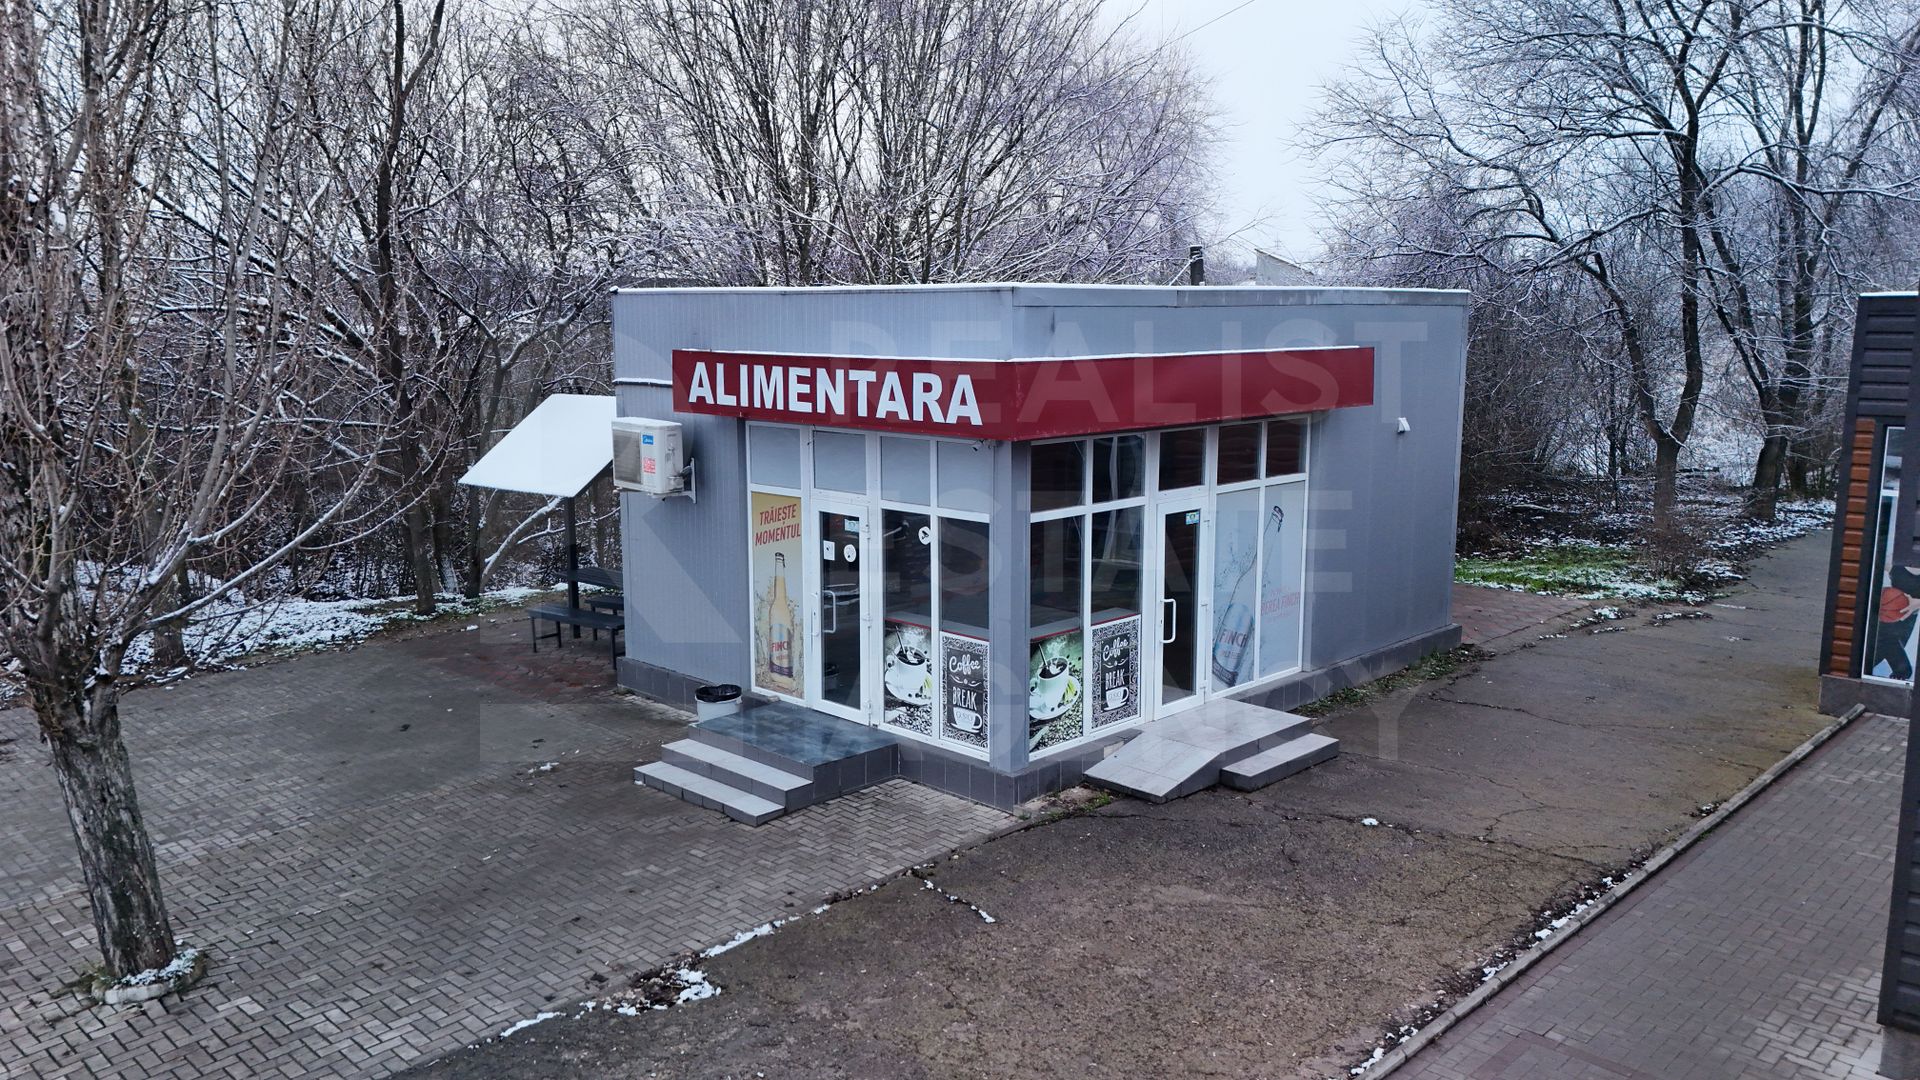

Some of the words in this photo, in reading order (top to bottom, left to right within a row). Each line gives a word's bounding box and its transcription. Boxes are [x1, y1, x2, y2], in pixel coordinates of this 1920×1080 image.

[688, 361, 983, 426] ALIMENTARA
[754, 522, 801, 547] MOMENTUL
[1102, 636, 1129, 661] Coffee
[948, 653, 981, 675] Coffee
[1105, 668, 1125, 690] BREAK
[952, 686, 977, 711] BREAK
